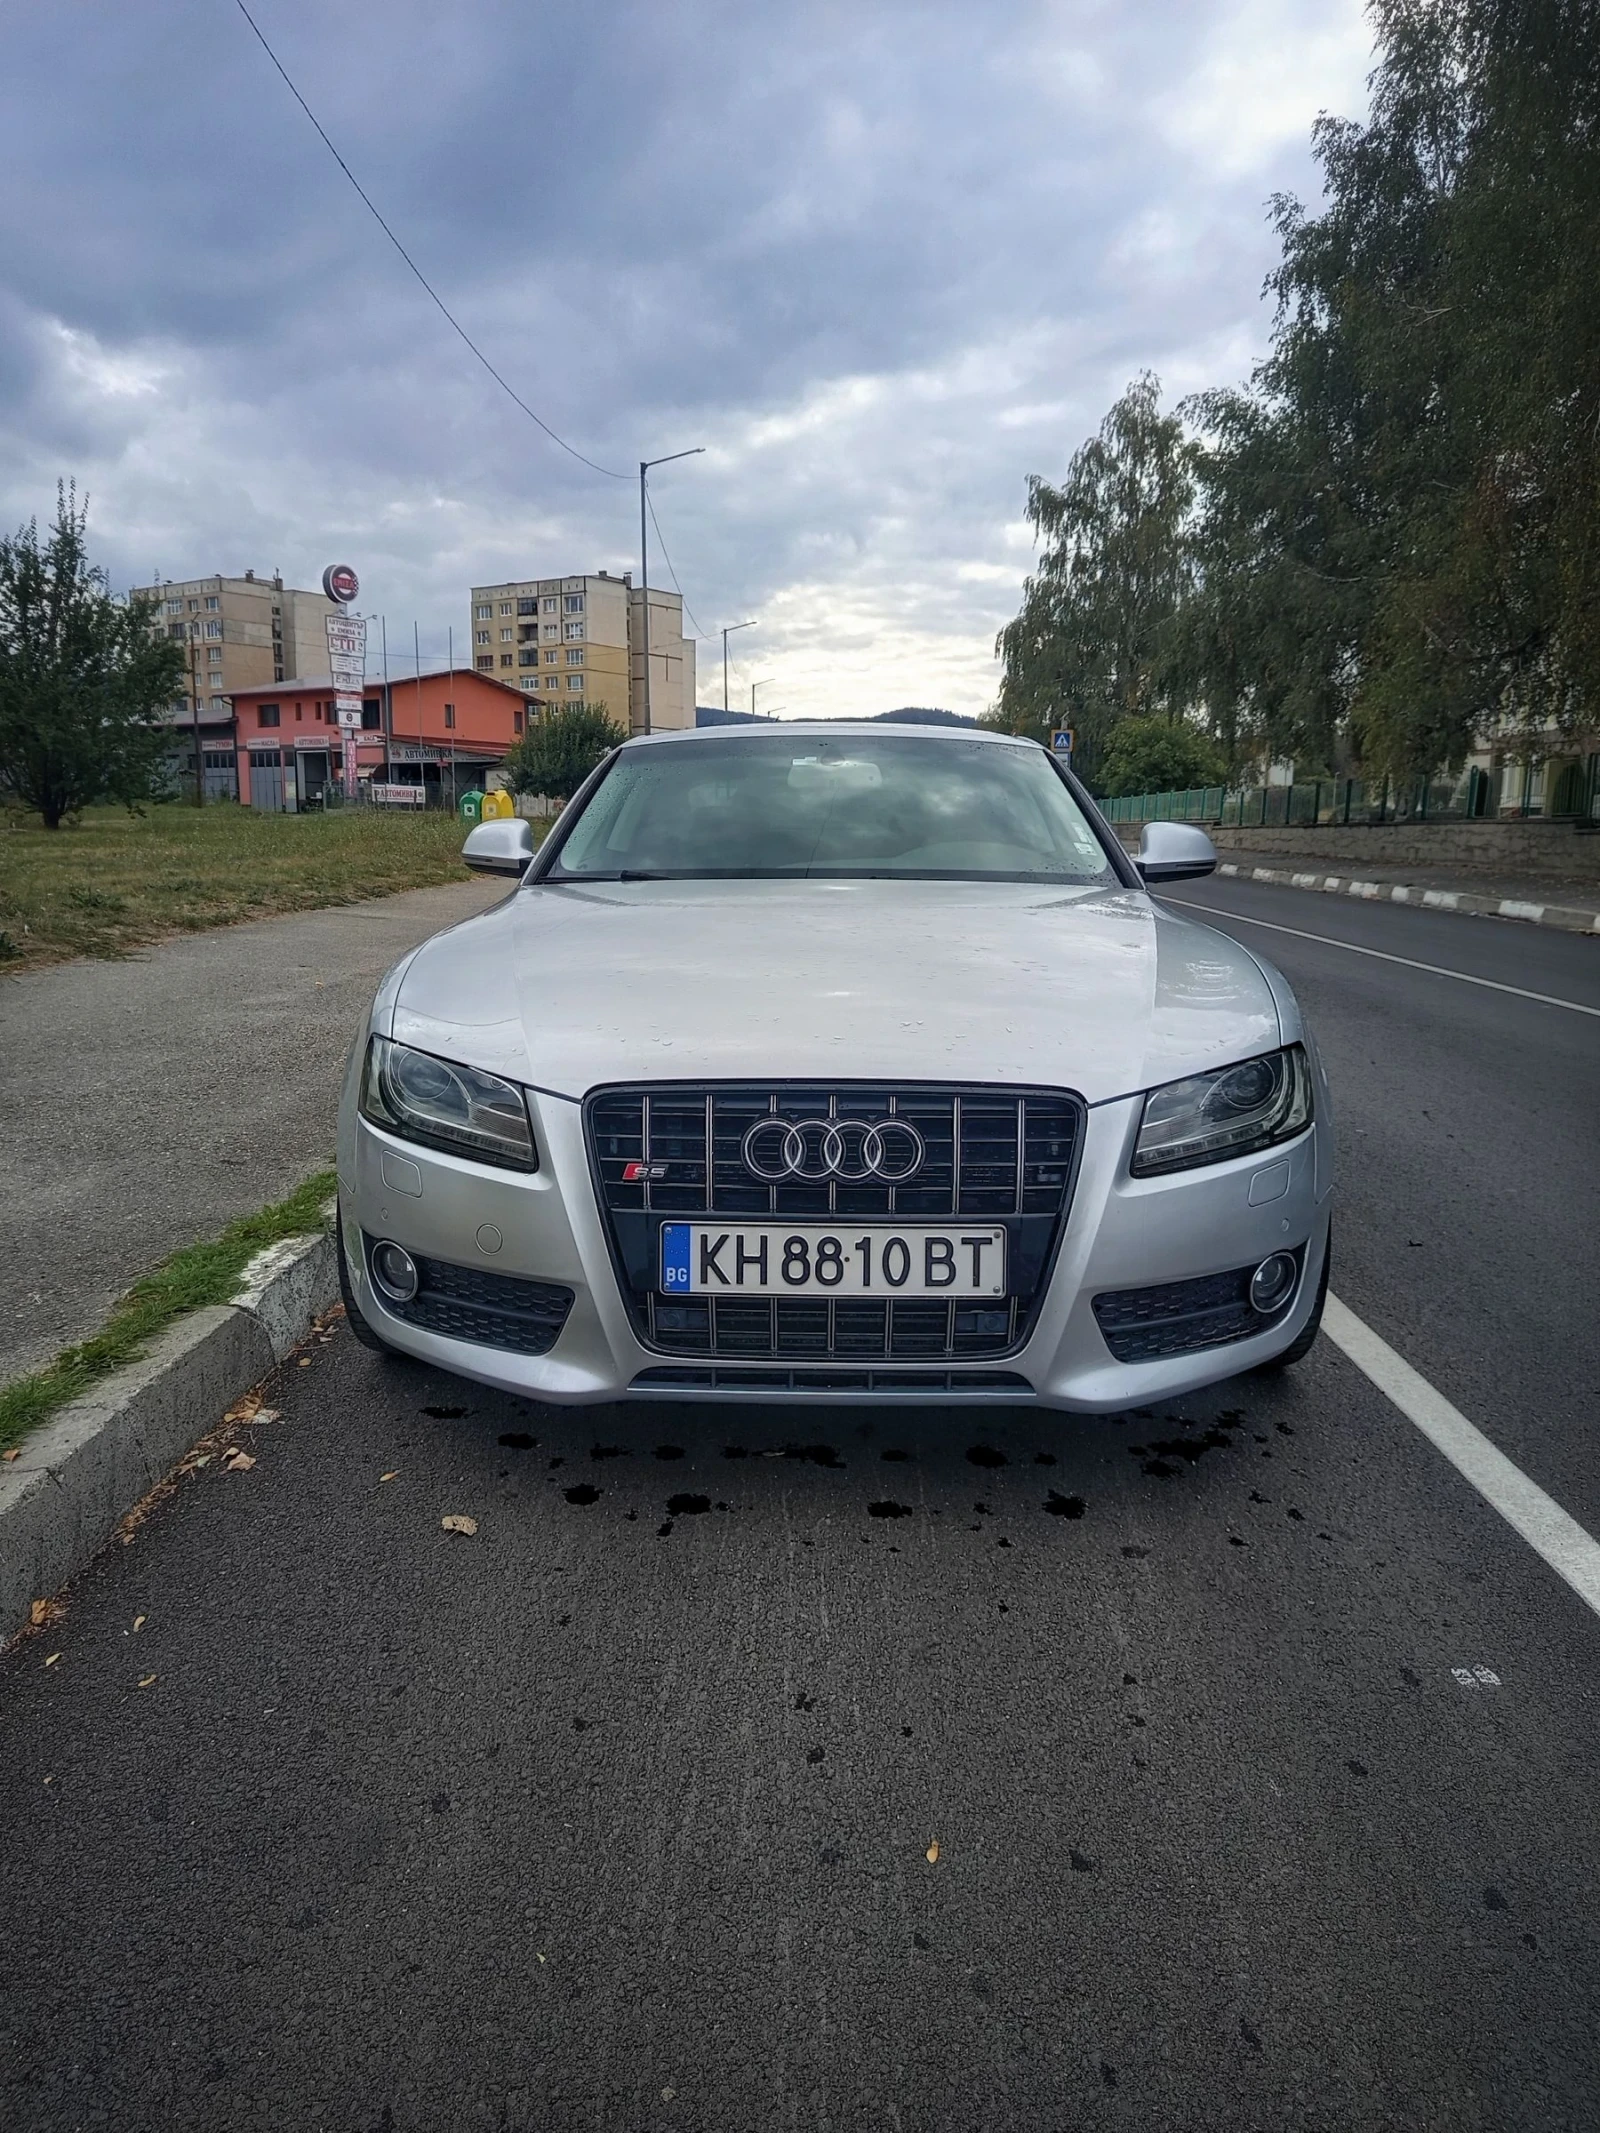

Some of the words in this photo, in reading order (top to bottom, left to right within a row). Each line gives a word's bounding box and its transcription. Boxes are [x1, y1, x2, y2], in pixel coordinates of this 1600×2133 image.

[328, 618, 364, 630] АВТОЦЕНТЪР
[404, 749, 453, 759] АВТОМИВКА
[633, 1167, 666, 1178] S5
[666, 1267, 688, 1283] BG
